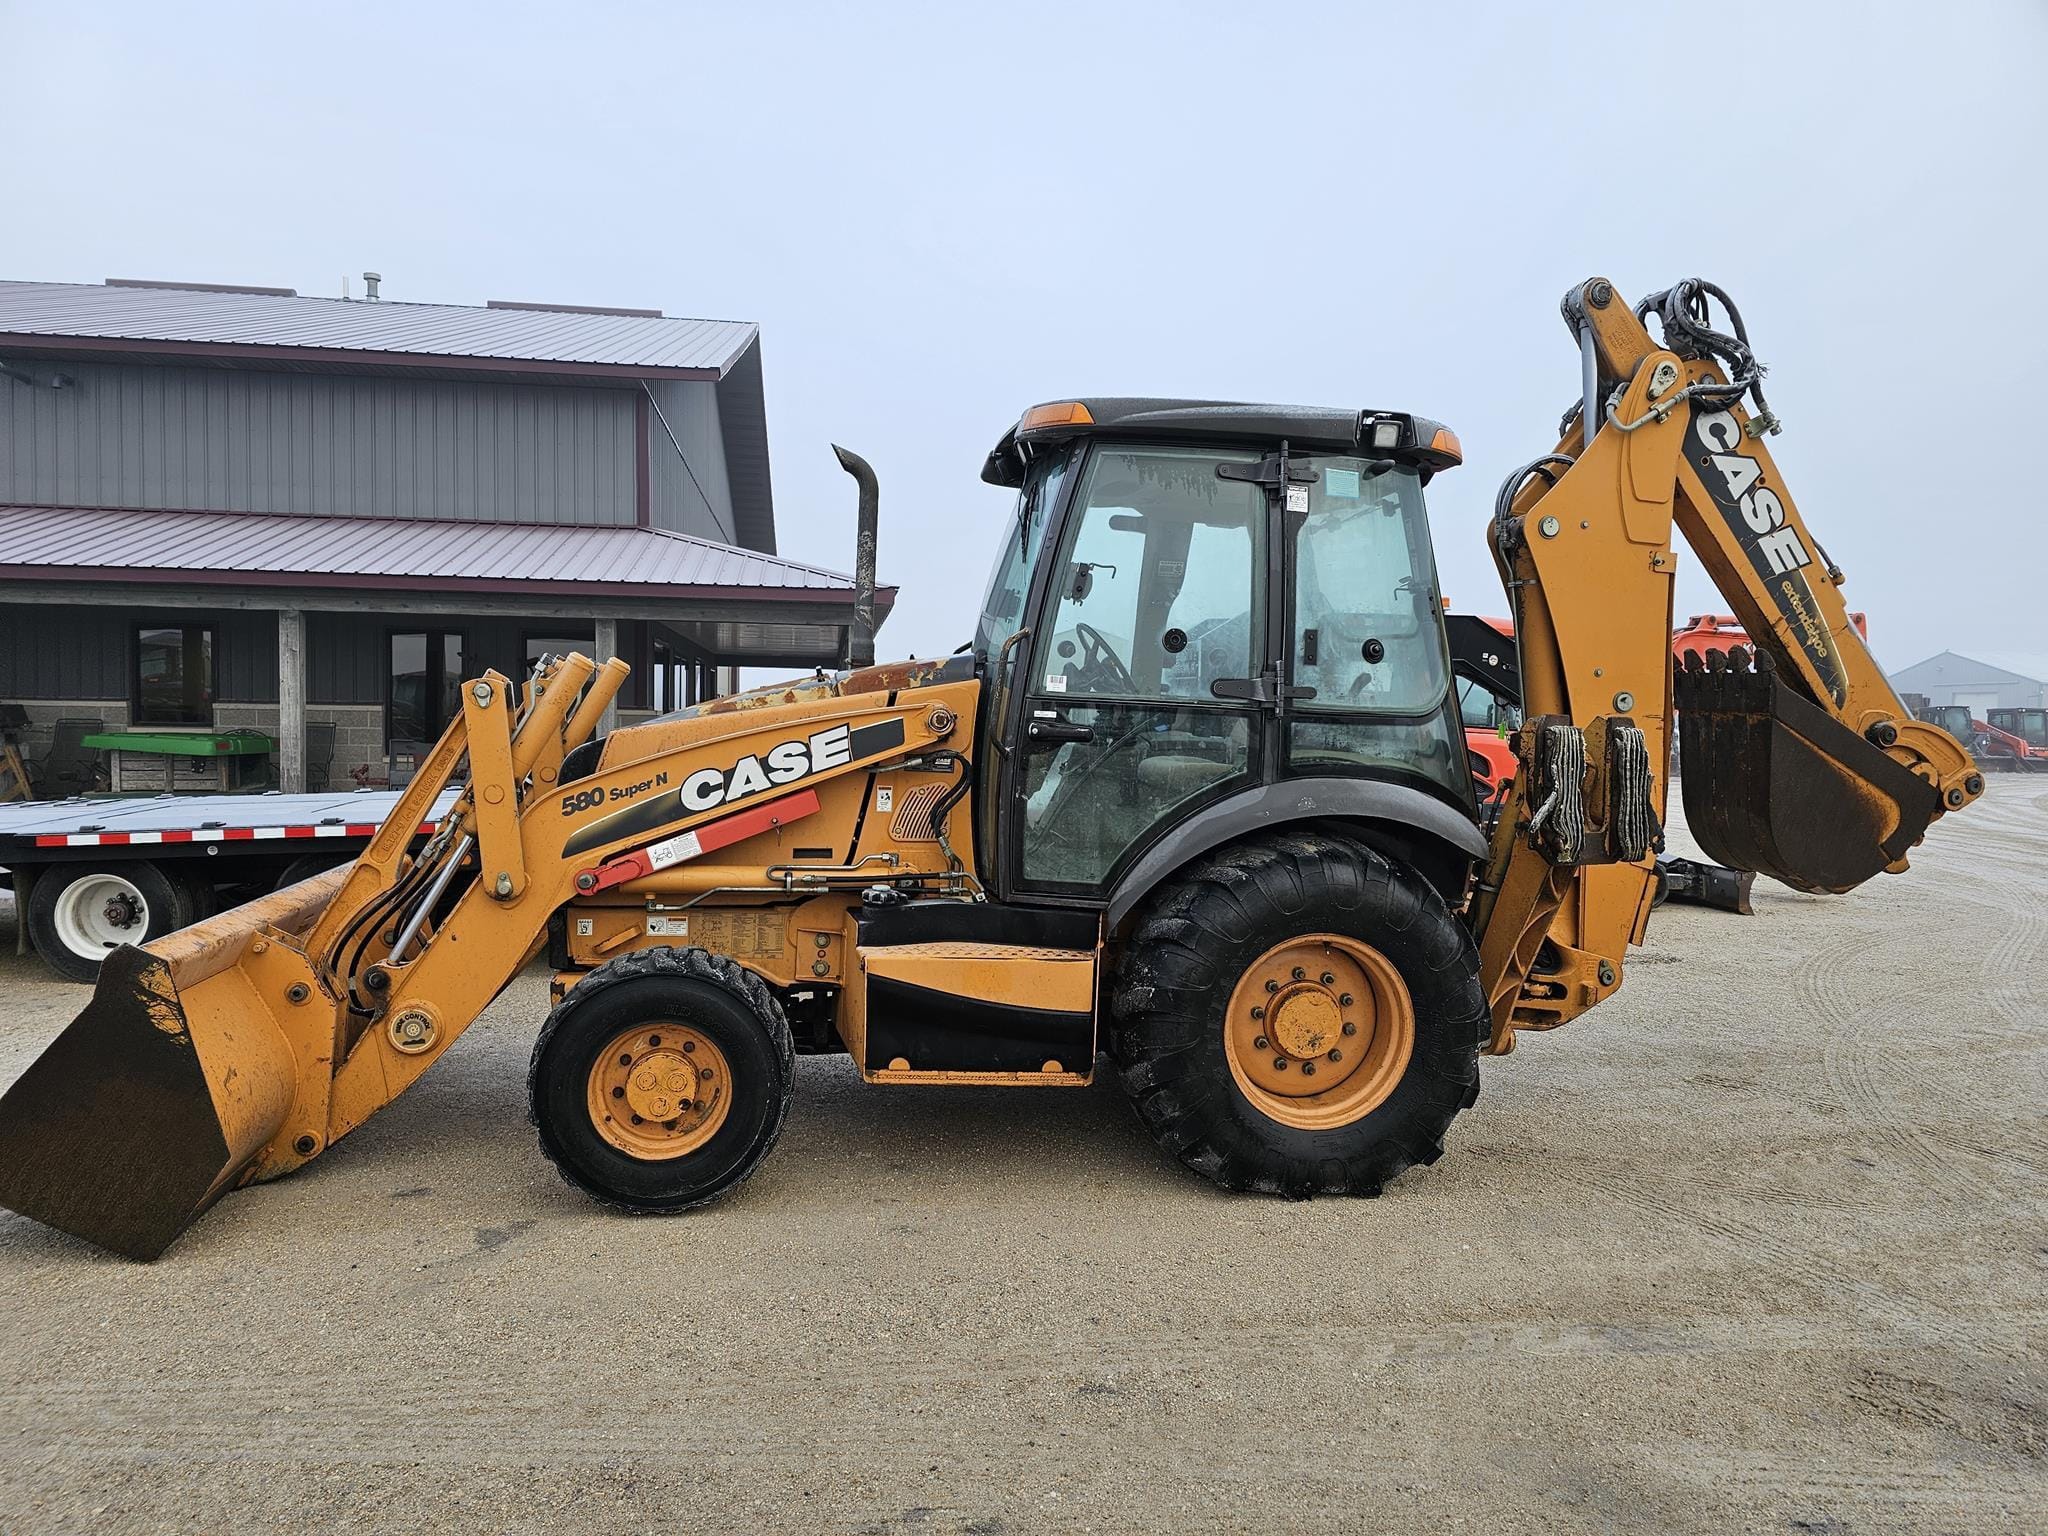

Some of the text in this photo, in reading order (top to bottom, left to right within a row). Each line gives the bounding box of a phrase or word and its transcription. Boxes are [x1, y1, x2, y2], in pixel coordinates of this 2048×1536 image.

[1696, 410, 1812, 576] CASE
[562, 772, 668, 816] 580 Super N
[680, 724, 850, 811] CASE
[404, 1013, 430, 1031] CONTROL
